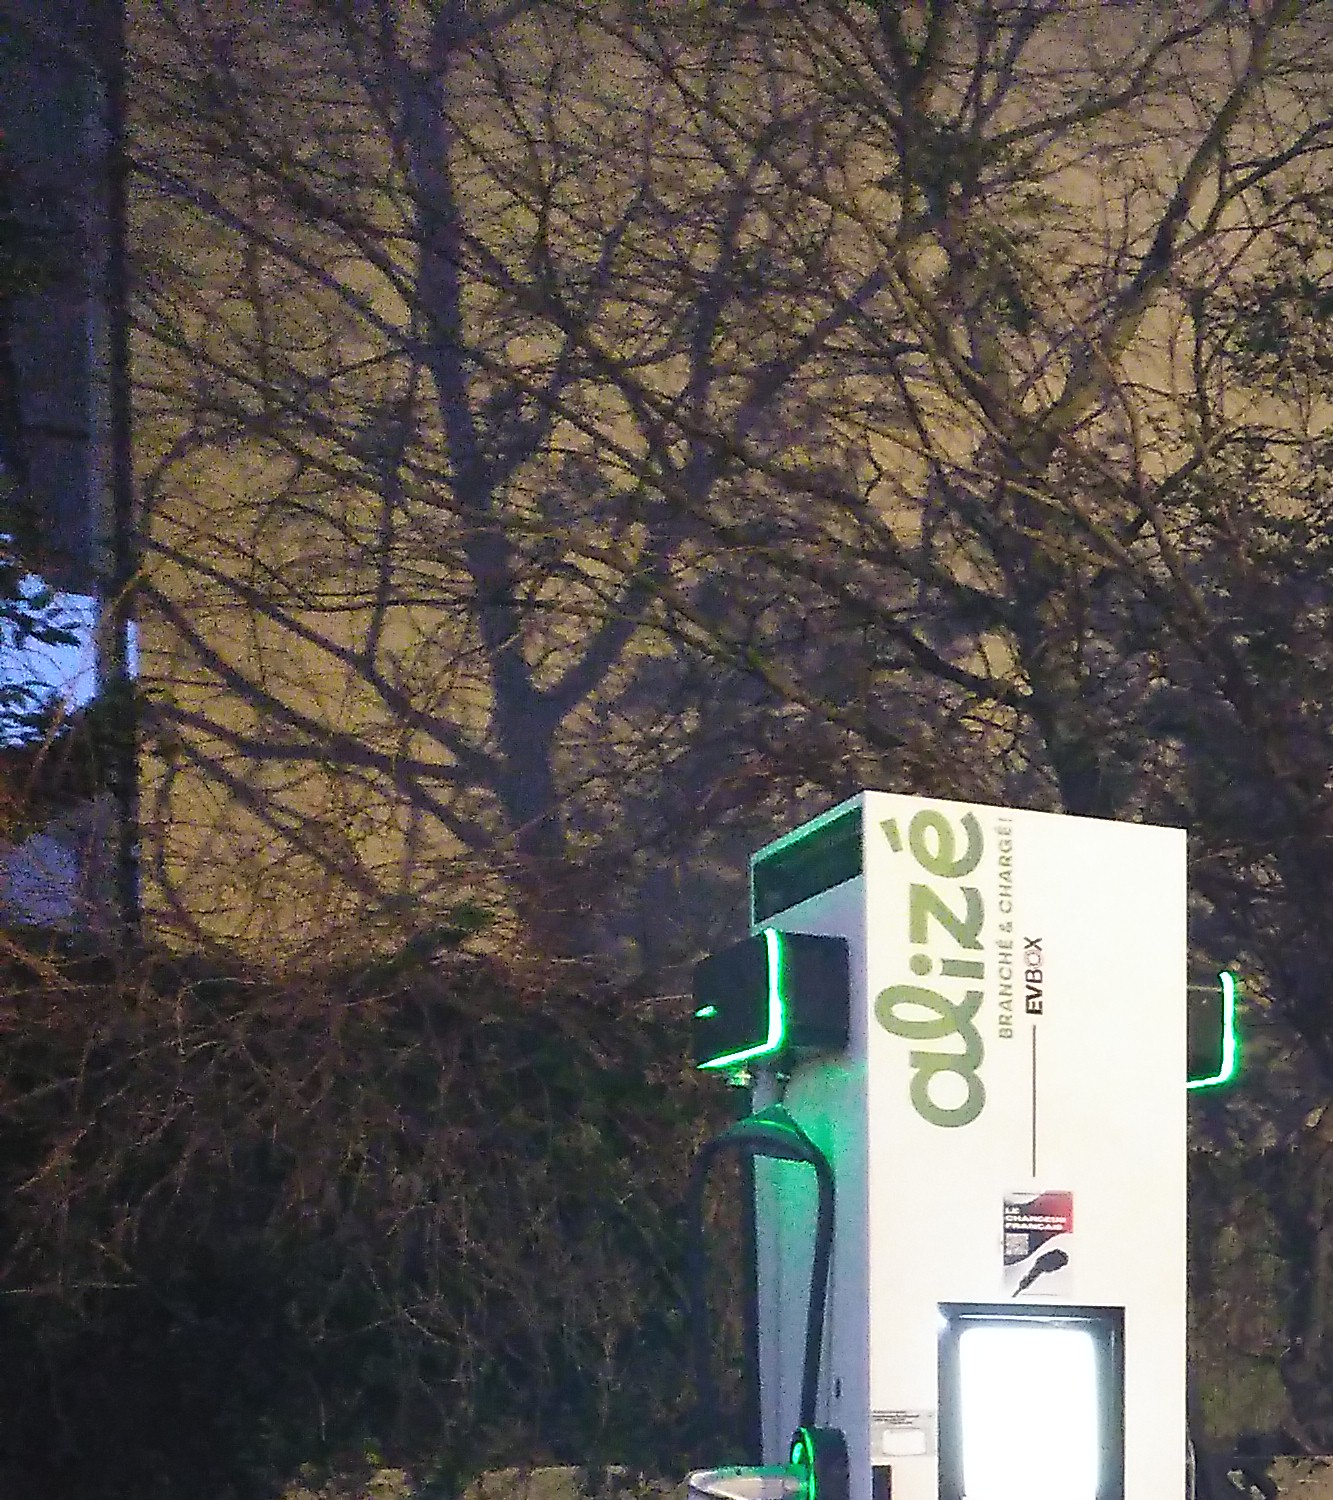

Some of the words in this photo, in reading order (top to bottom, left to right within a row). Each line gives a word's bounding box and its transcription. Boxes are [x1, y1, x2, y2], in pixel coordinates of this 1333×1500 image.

[874, 809, 986, 1128] alizé
[999, 922, 1014, 935] &
[995, 938, 1014, 1040] BRANCHÉ
[1024, 937, 1043, 1015] EVBOX
